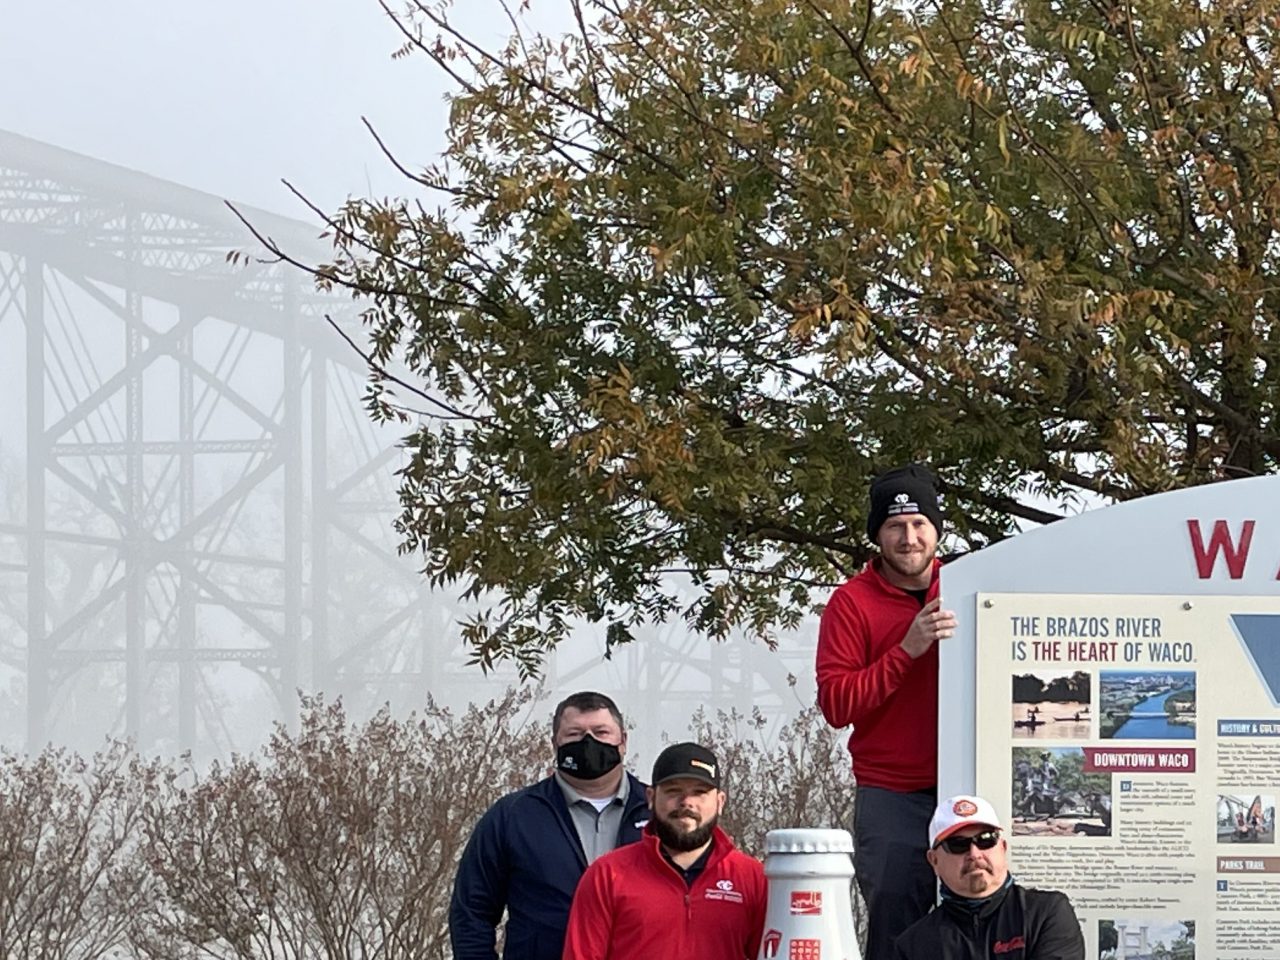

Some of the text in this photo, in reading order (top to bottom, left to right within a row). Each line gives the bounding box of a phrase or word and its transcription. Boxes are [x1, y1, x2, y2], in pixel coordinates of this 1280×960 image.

[1011, 617, 1161, 637] THE BRAZOS RIVER
[1012, 641, 1027, 661] IS
[1032, 641, 1061, 661] THE
[1068, 642, 1118, 661] HEART
[1124, 643, 1142, 662] OF
[1220, 724, 1250, 734] HISTORY
[1094, 753, 1189, 767] DOWNTOWN WACO
[1220, 860, 1265, 870] PARKS TRAIL
